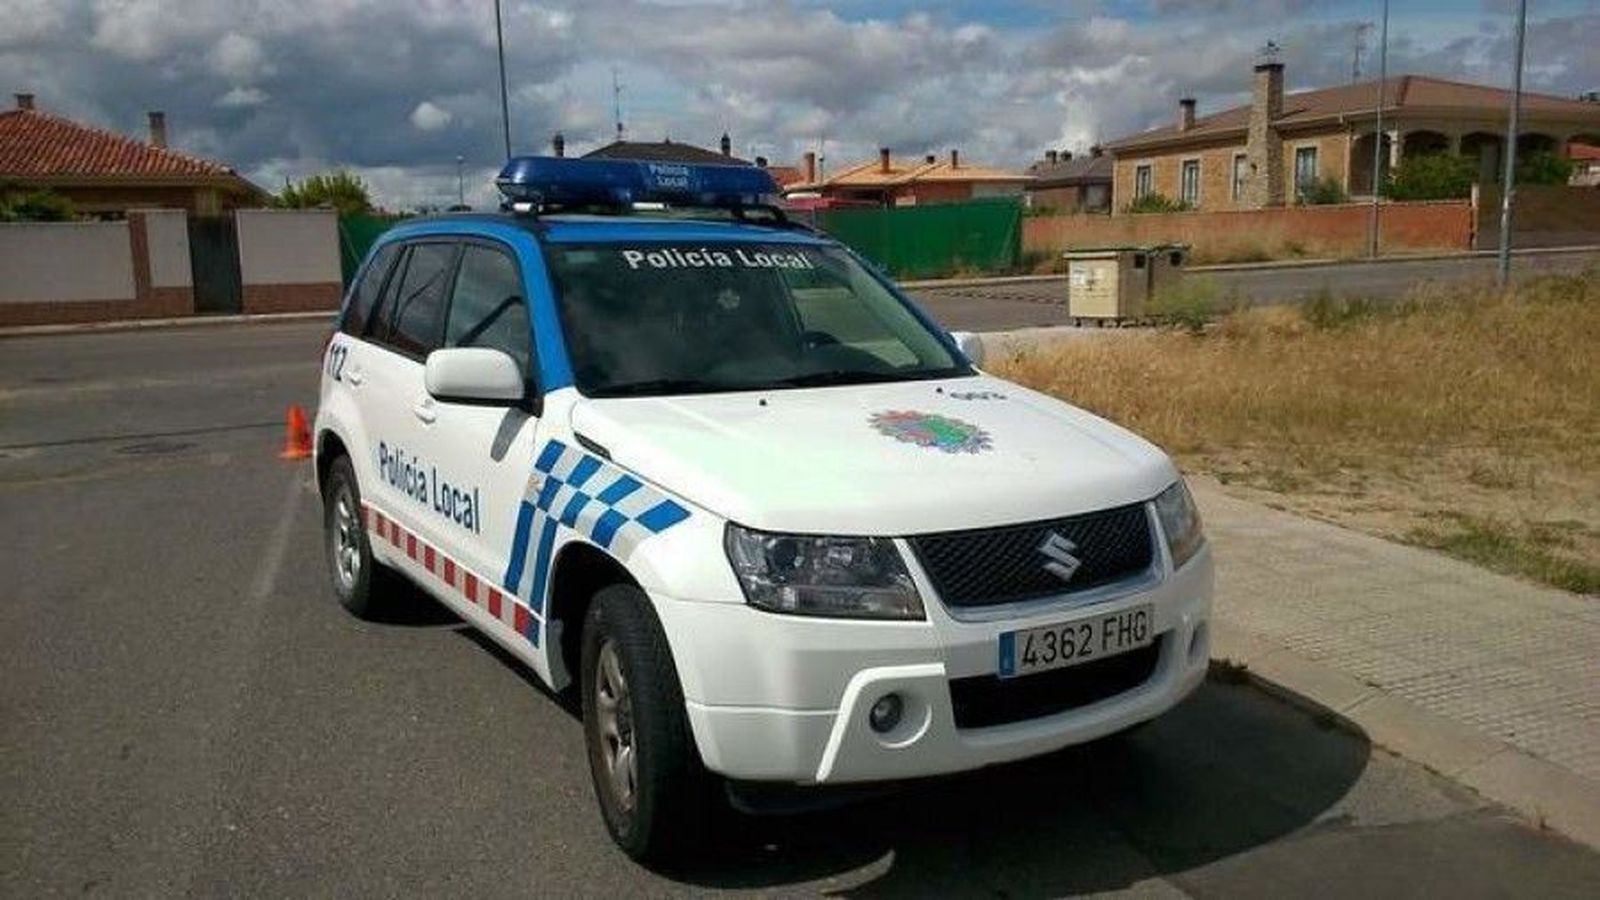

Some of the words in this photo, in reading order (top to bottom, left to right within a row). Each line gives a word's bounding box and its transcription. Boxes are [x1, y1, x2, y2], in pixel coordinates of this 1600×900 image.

[622, 248, 733, 269] Policía
[736, 249, 814, 269] Local
[432, 466, 480, 534] Local
[1021, 623, 1093, 667] 4362
[1101, 610, 1147, 651] FHG
